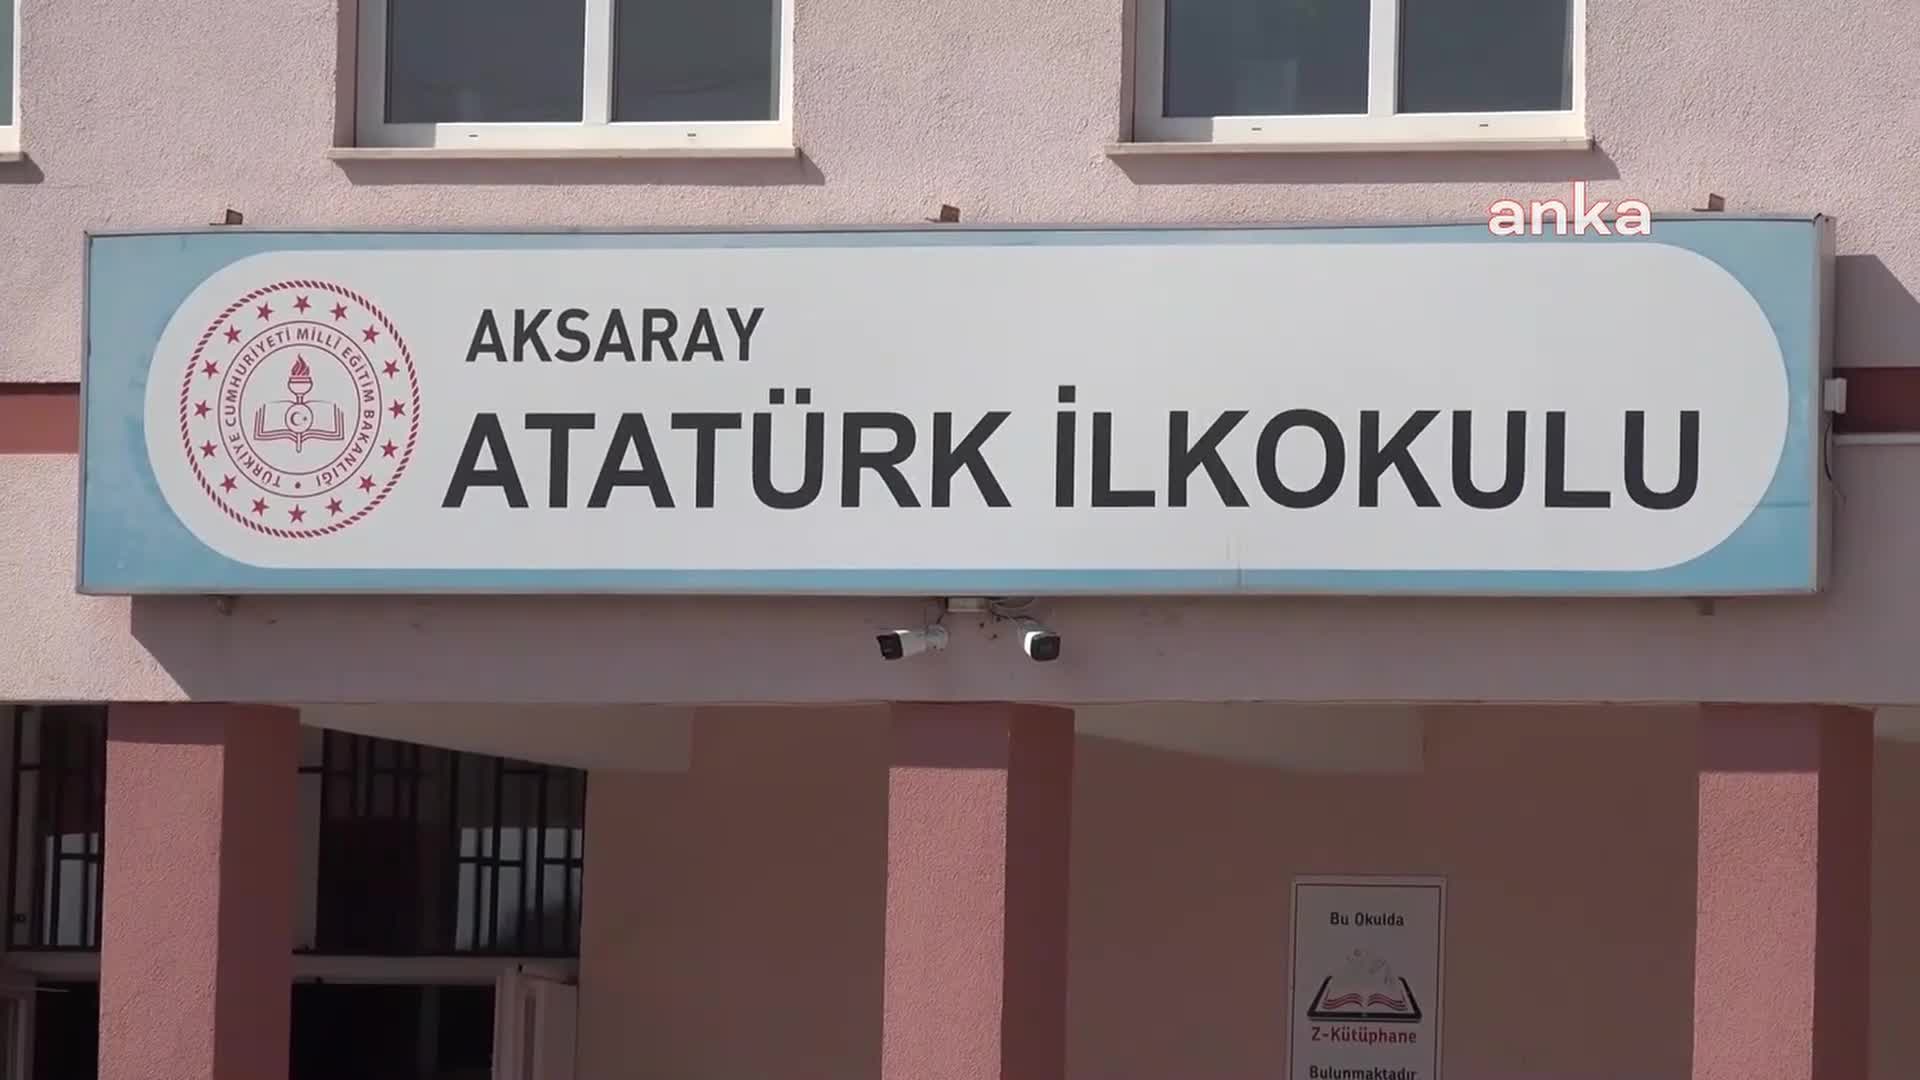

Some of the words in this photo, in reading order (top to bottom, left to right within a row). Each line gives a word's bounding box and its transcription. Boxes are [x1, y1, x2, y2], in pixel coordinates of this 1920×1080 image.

[296, 327, 342, 350] MİLLİ
[466, 308, 764, 362] AKSARAY
[225, 327, 291, 427] CUMHURİYETİ
[341, 347, 376, 403] EĞİTİM
[229, 432, 281, 488] TÜRKİYE
[315, 410, 375, 487] BAKANLIĞI
[442, 388, 1011, 509] ATATÜRK
[1056, 386, 1699, 509] İLKOKULU
[1330, 912, 1349, 926] Bu
[1355, 912, 1404, 926] Okulda
[1312, 1026, 1417, 1045] Z-Kütüphane
